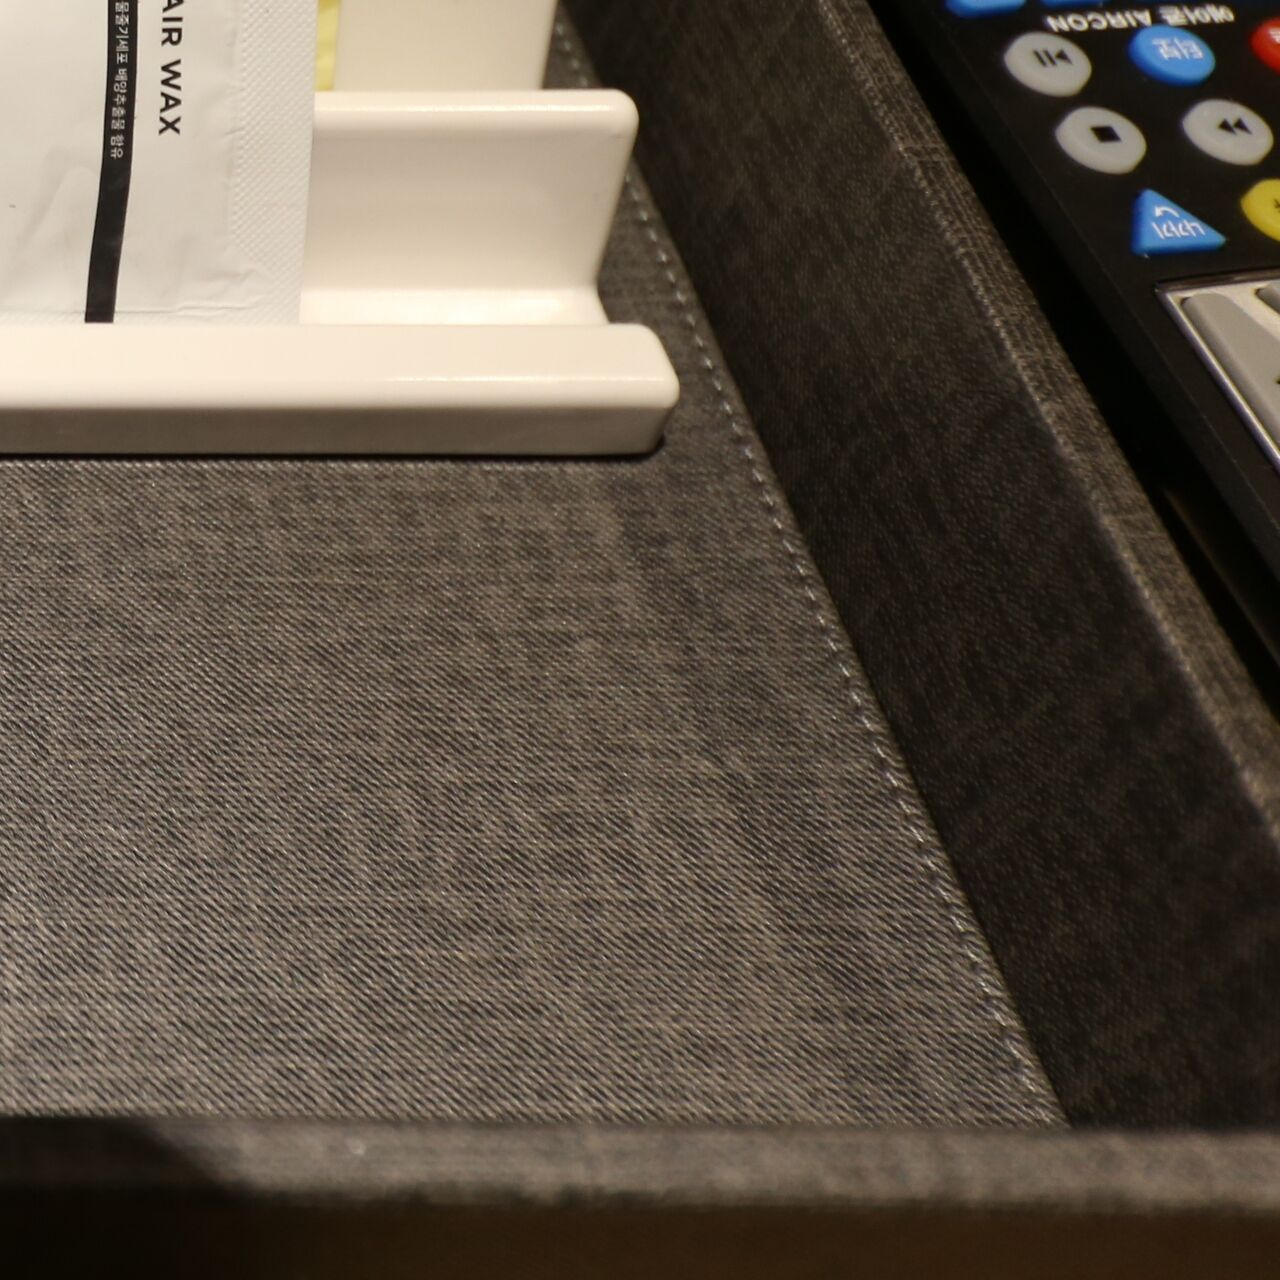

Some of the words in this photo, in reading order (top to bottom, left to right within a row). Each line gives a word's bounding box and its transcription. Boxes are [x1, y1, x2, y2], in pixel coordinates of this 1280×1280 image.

[1045, 8, 1153, 33] AIRCON
[110, 67, 128, 131] 배양추출물
[158, 58, 183, 137] WAX
[110, 134, 125, 161] 함유
[1151, 220, 1206, 241] 나가기
